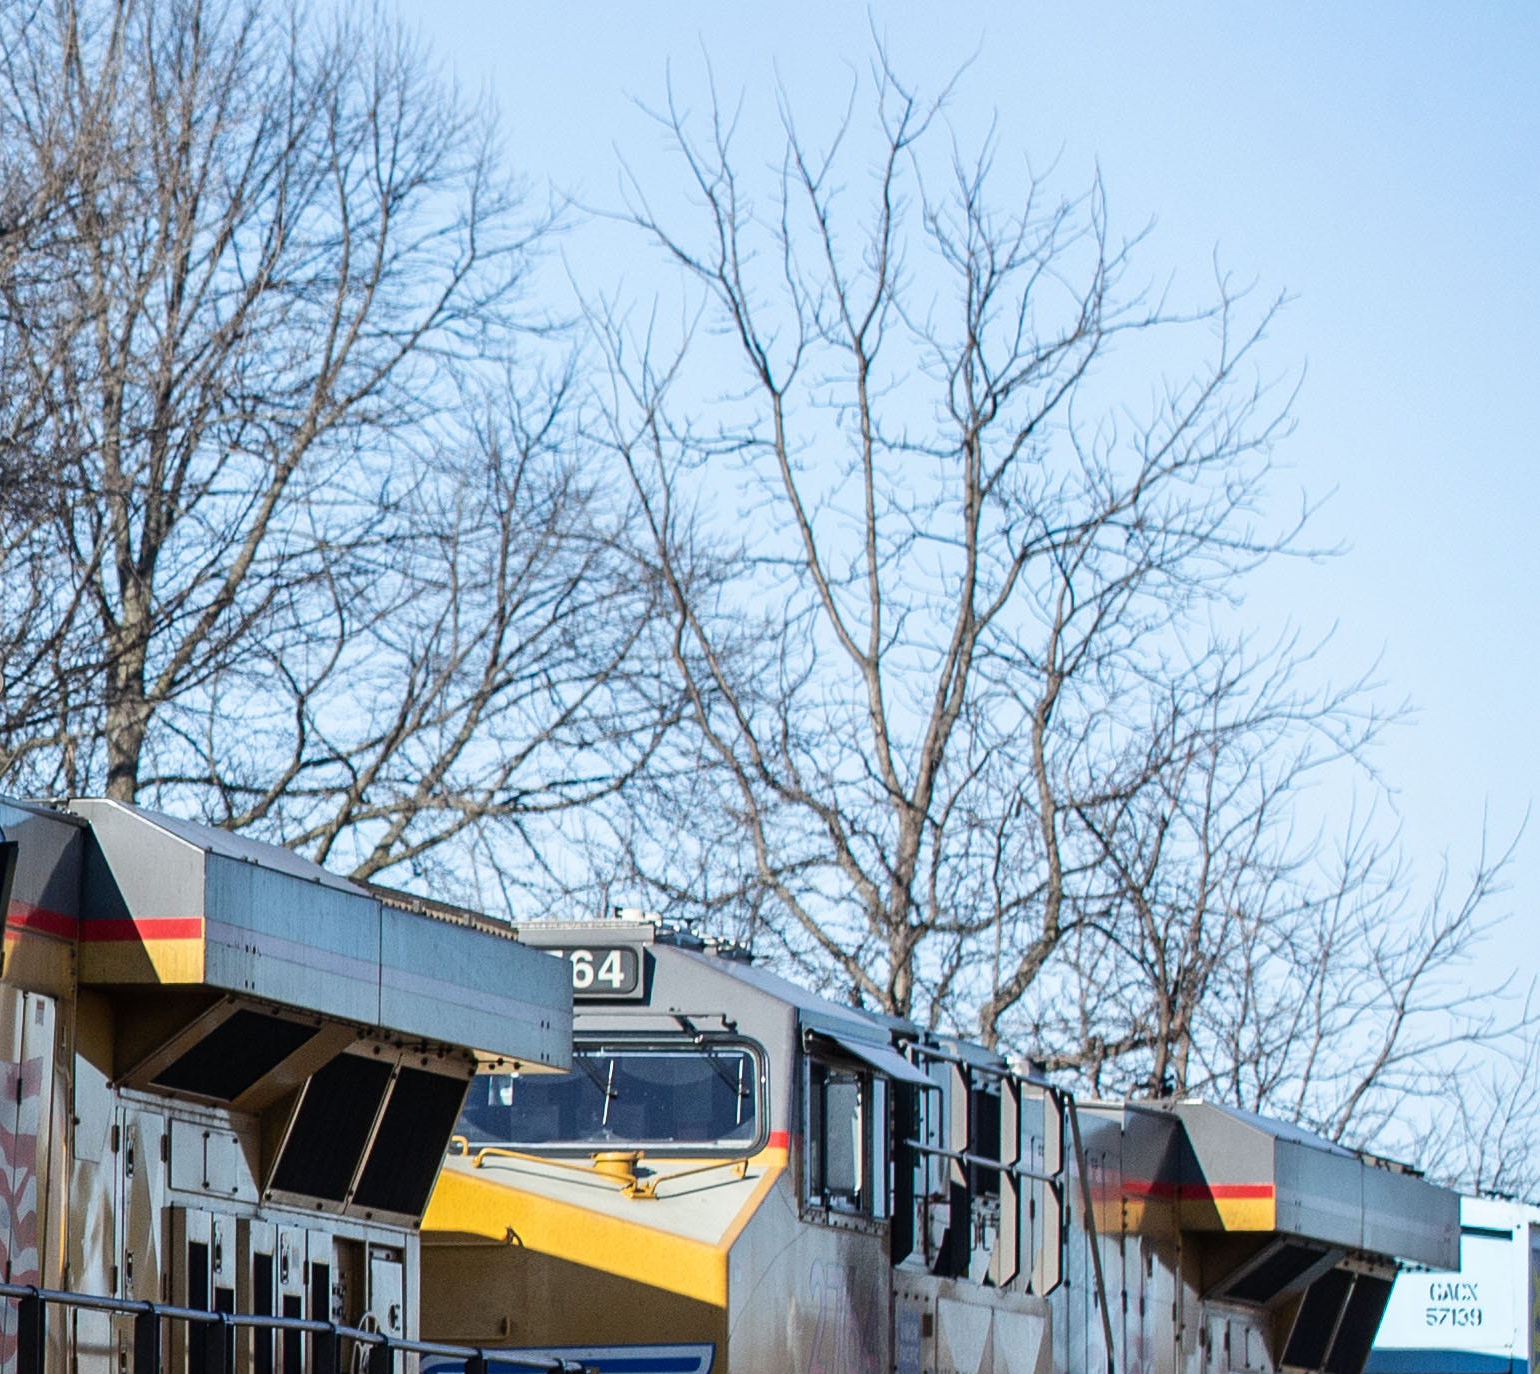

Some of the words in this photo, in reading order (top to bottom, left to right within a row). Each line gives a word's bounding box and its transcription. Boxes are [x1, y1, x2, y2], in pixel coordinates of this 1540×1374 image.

[546, 949, 625, 988] 64
[1429, 1282, 1478, 1301] GACX
[1426, 1307, 1483, 1326] 57139
